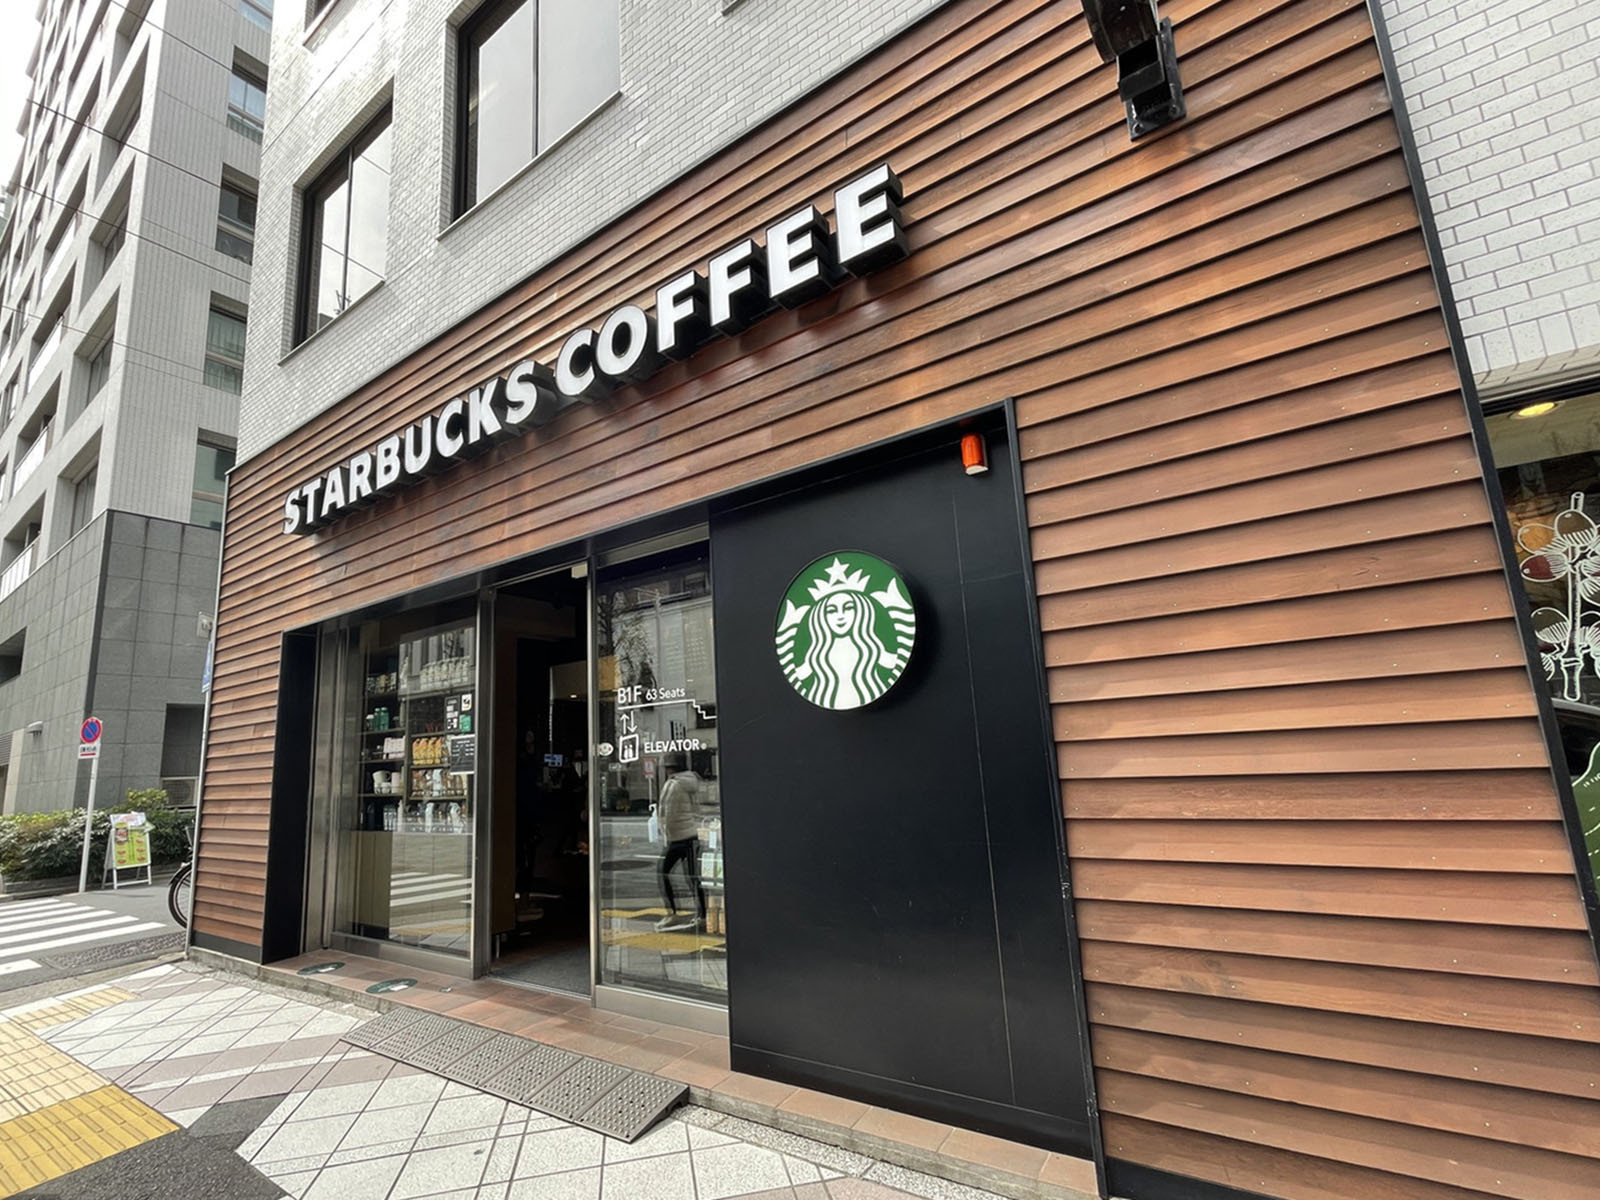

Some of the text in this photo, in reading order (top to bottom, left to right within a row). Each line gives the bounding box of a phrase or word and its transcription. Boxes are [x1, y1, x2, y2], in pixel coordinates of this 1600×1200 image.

[283, 162, 899, 535] STARBUCKS COFFEE
[617, 685, 686, 704] B1F 63 Seats
[643, 738, 700, 754] ELEVATOR
